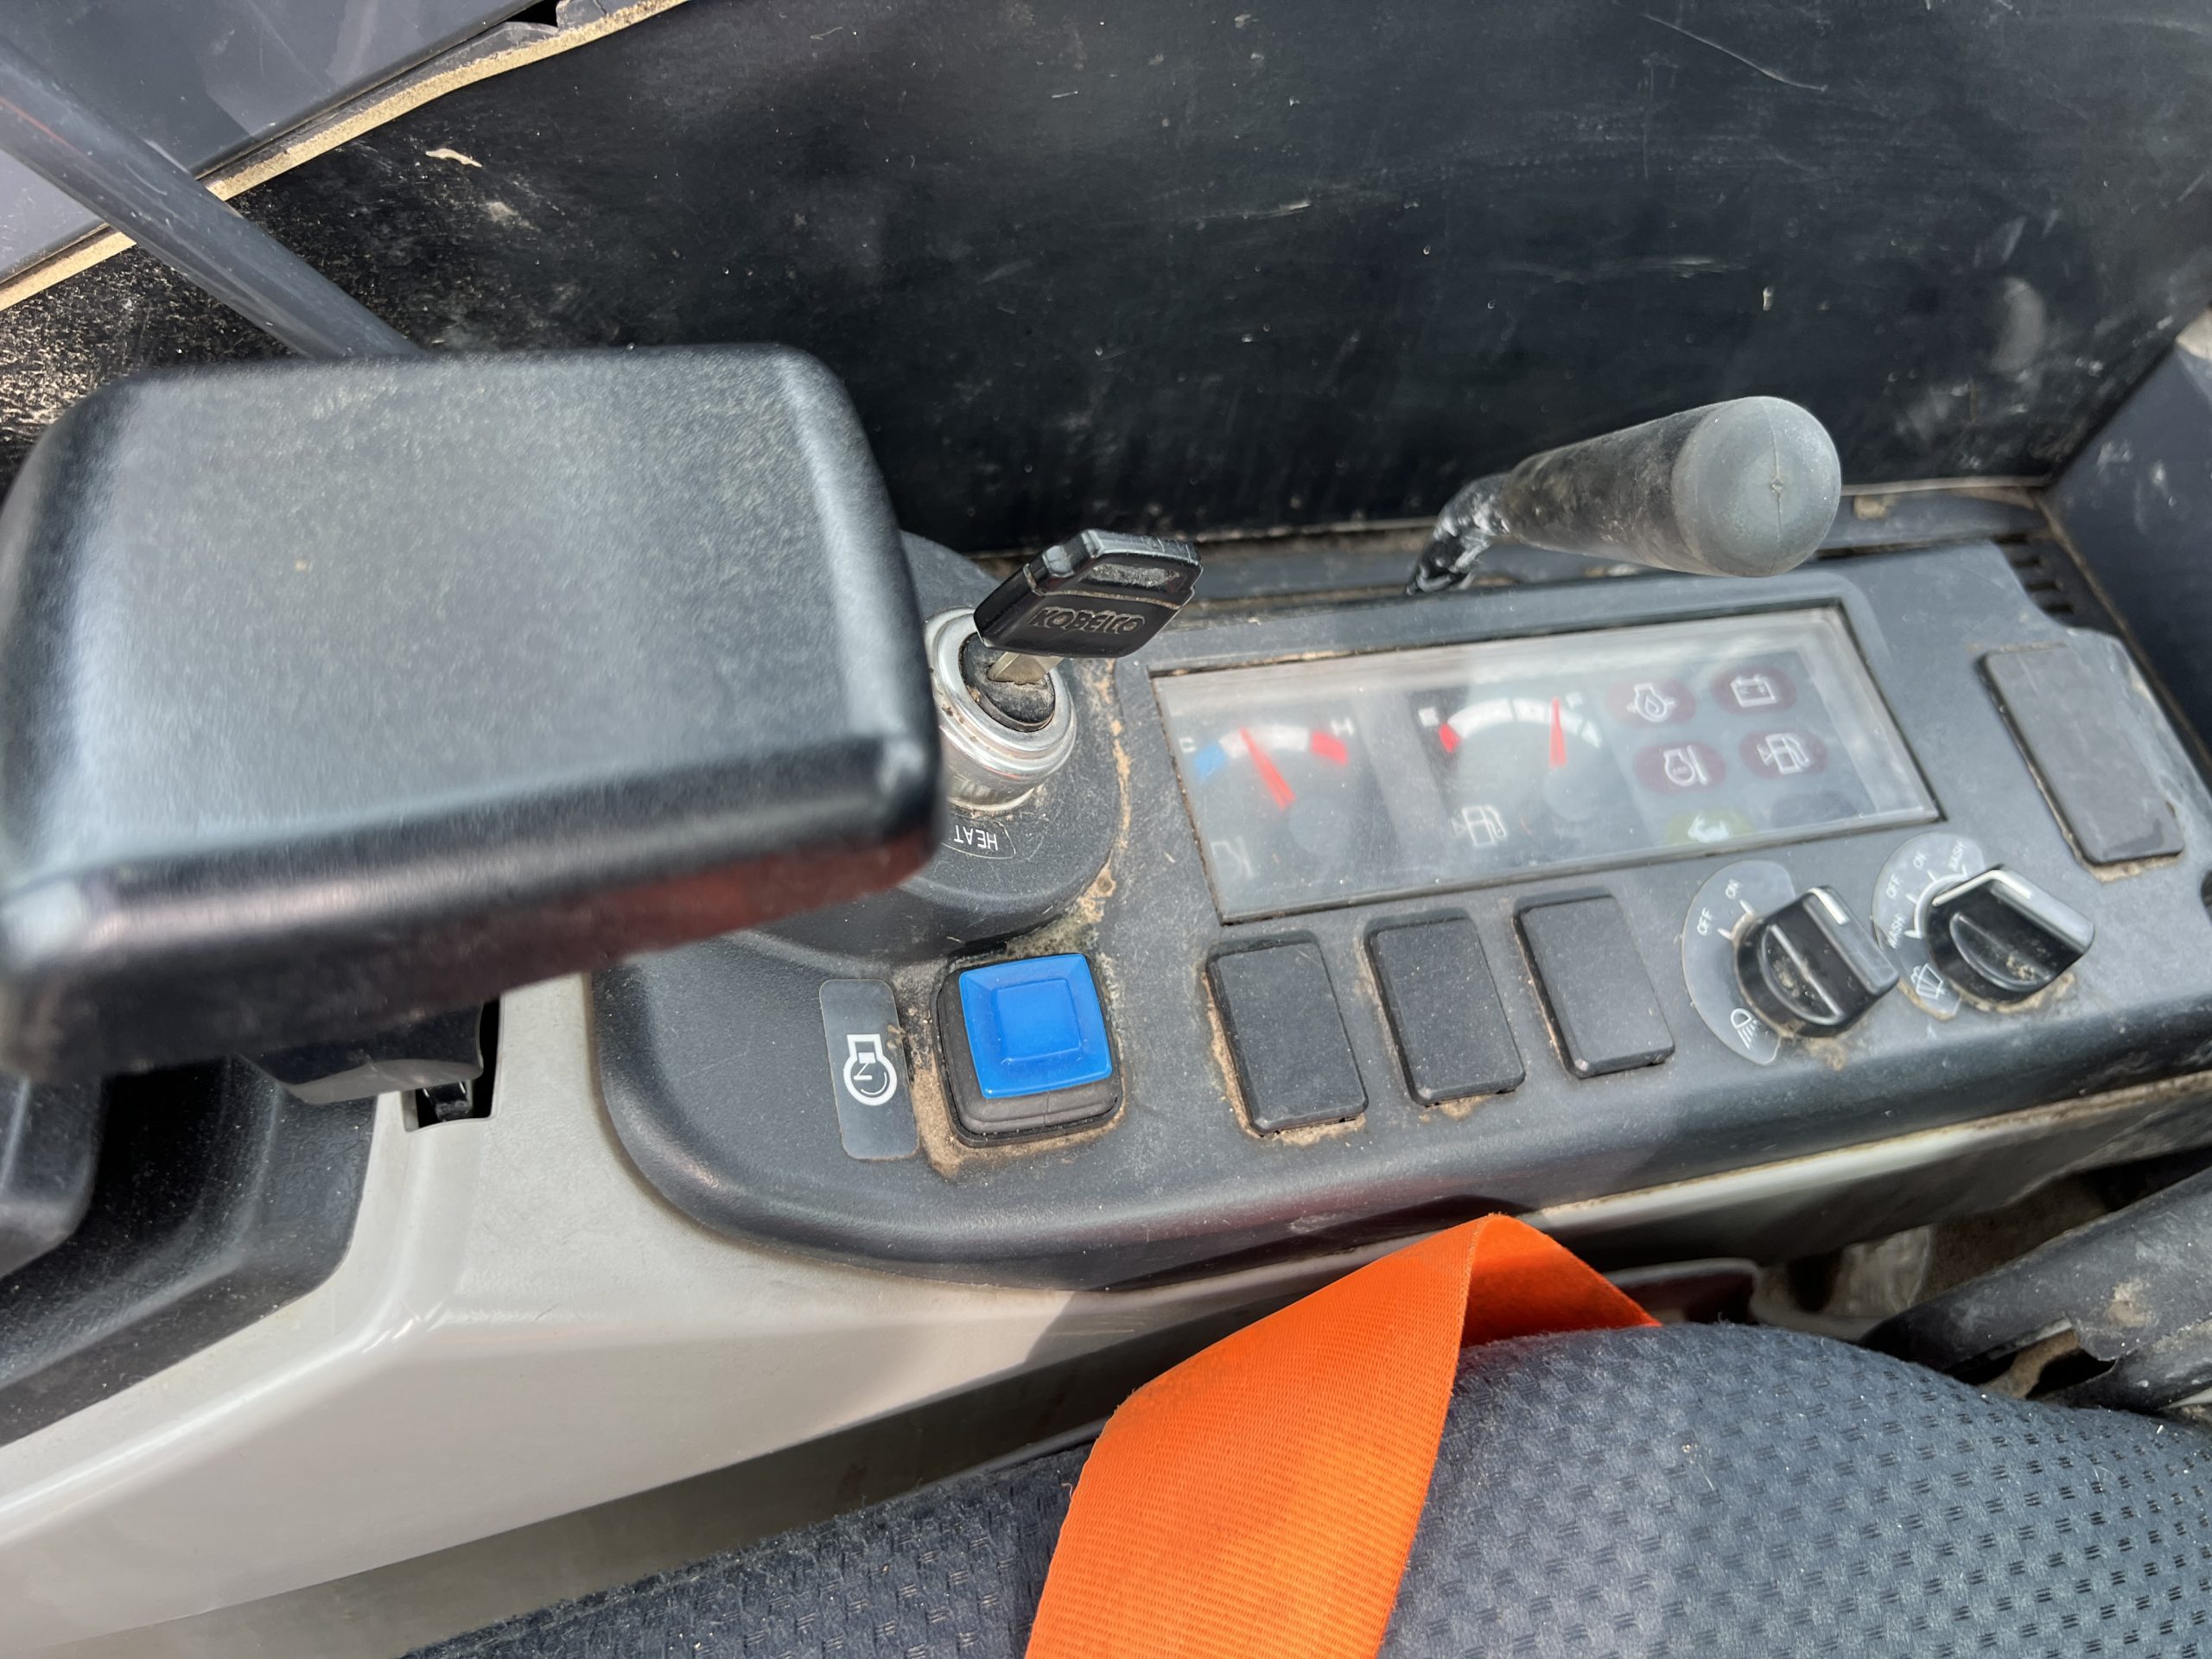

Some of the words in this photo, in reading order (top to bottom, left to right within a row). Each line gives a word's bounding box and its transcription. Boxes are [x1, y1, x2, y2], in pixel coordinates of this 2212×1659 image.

[1031, 607, 1145, 634] KOBELCO
[1331, 717, 1355, 737] H
[953, 824, 998, 851] HEAT
[1697, 906, 1713, 936] OFF
